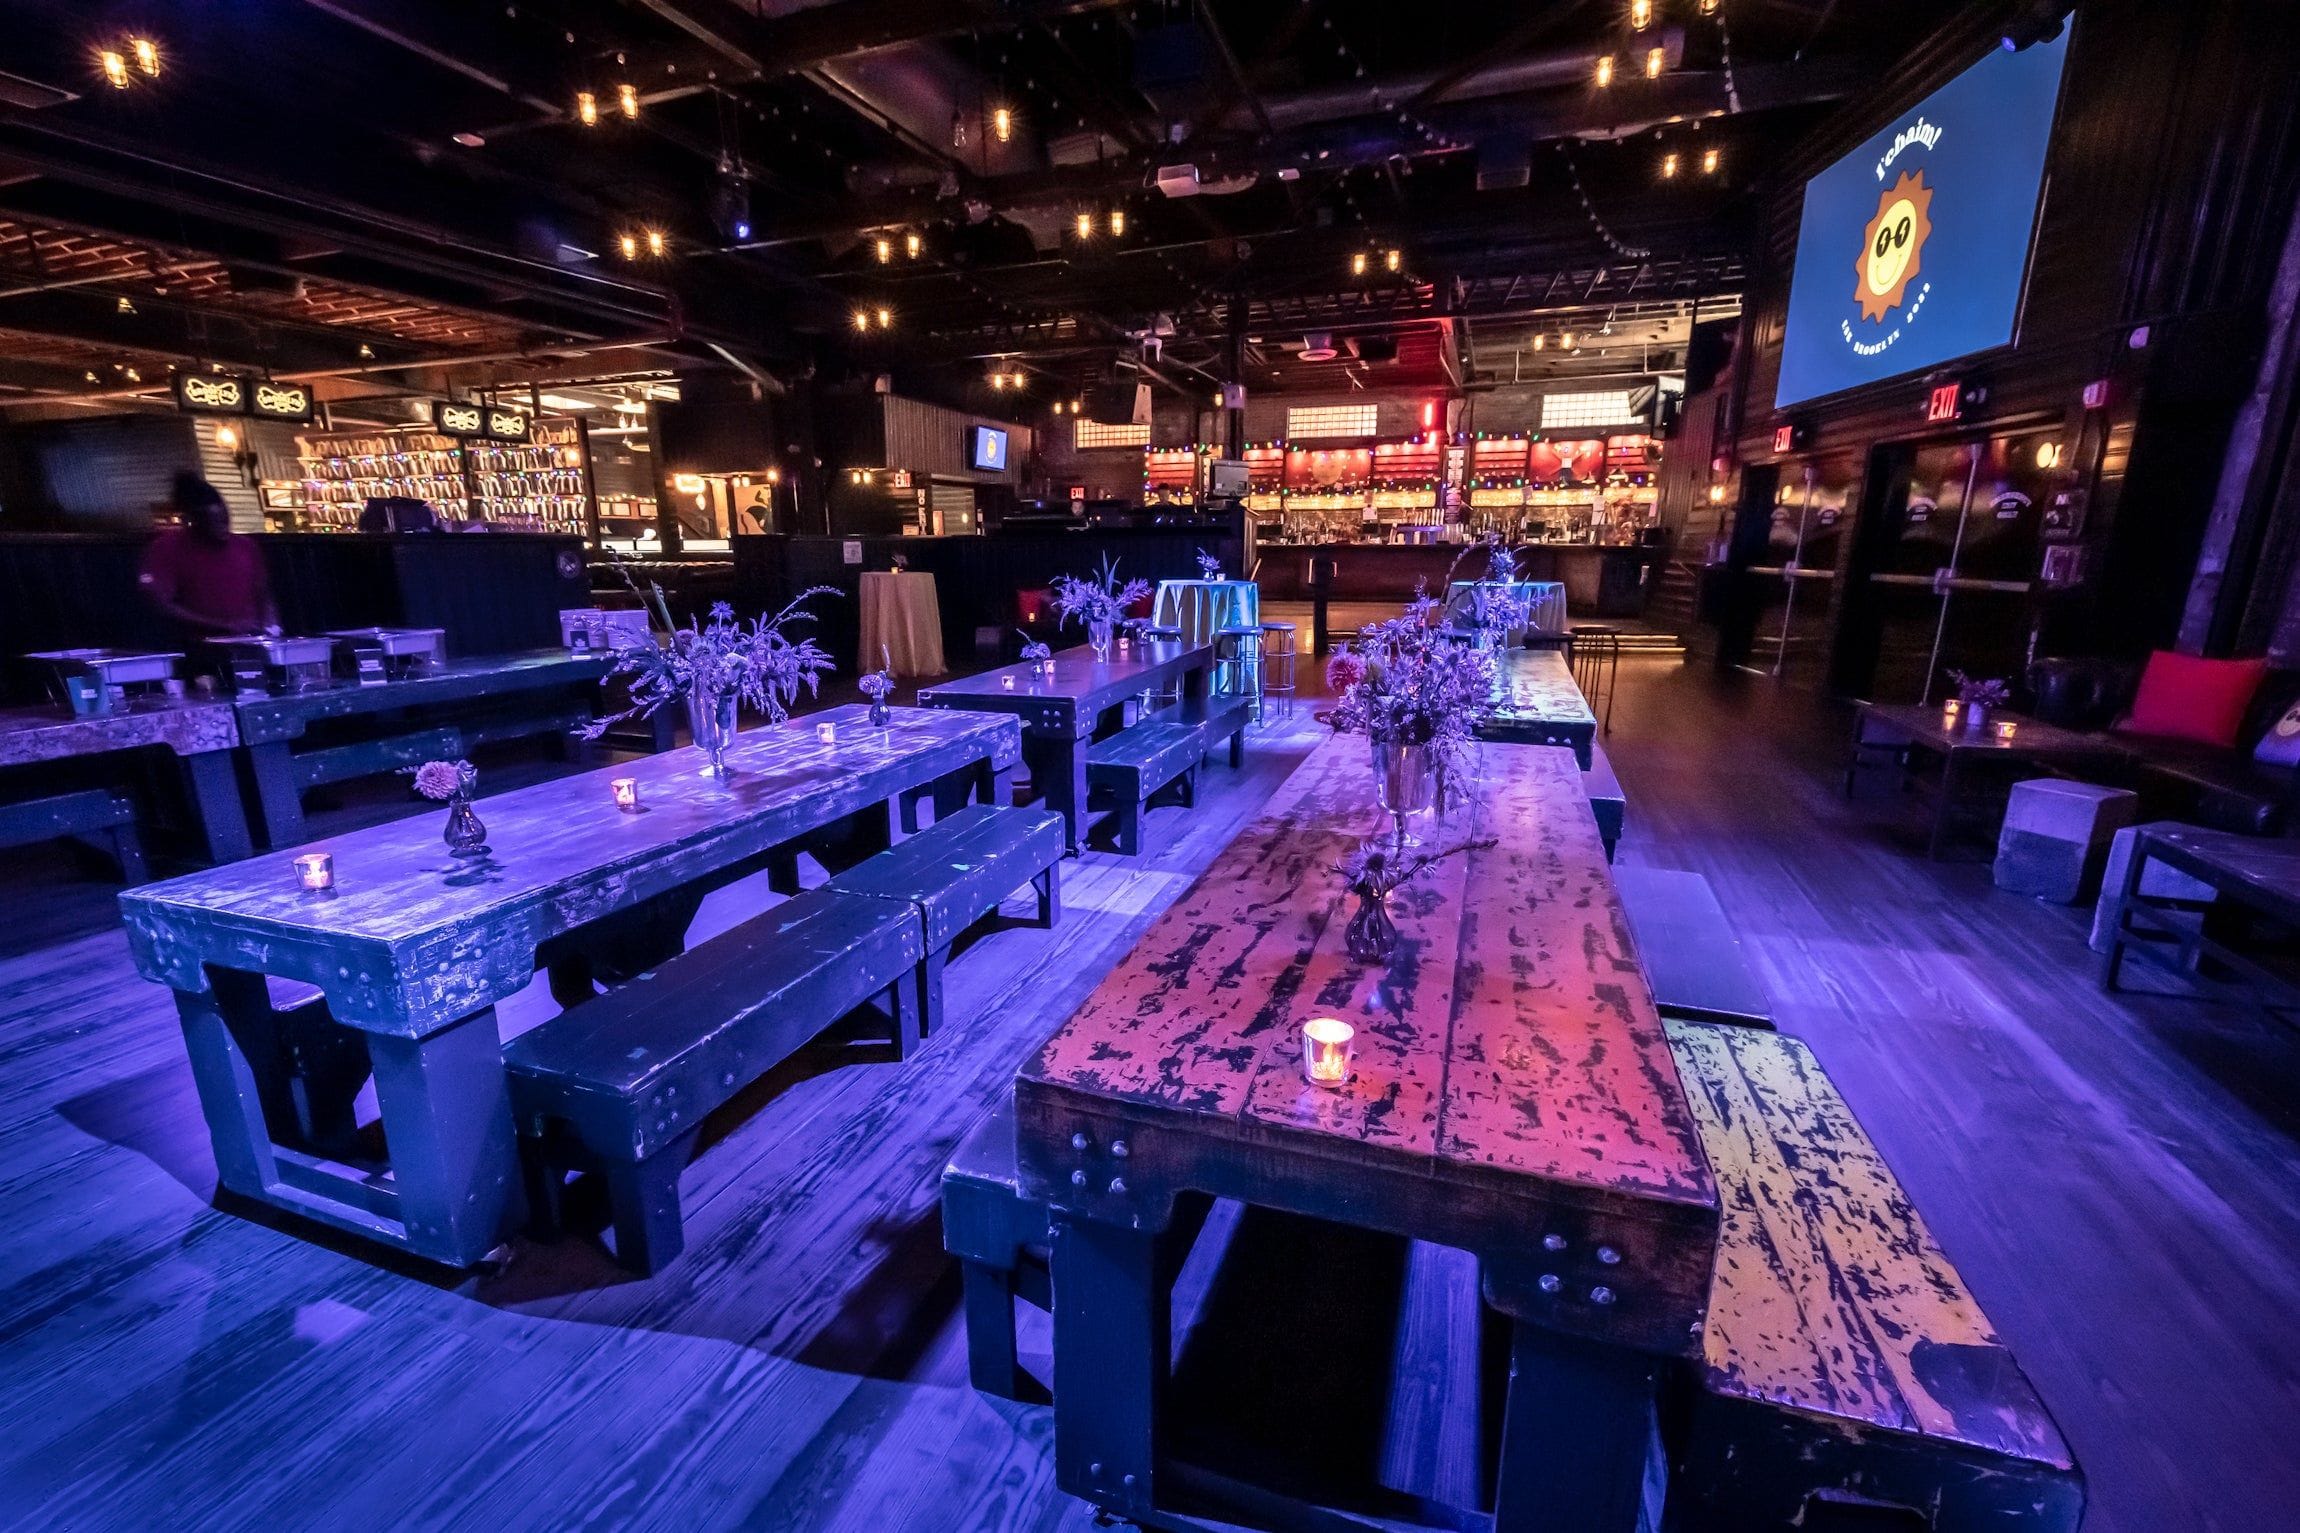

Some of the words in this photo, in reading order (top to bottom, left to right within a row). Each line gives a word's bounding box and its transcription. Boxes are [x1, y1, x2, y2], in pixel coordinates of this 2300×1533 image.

[1853, 328, 1900, 356] BROOKLYN
[1928, 384, 1960, 421] EXIT
[1774, 426, 1793, 453] EXIT
